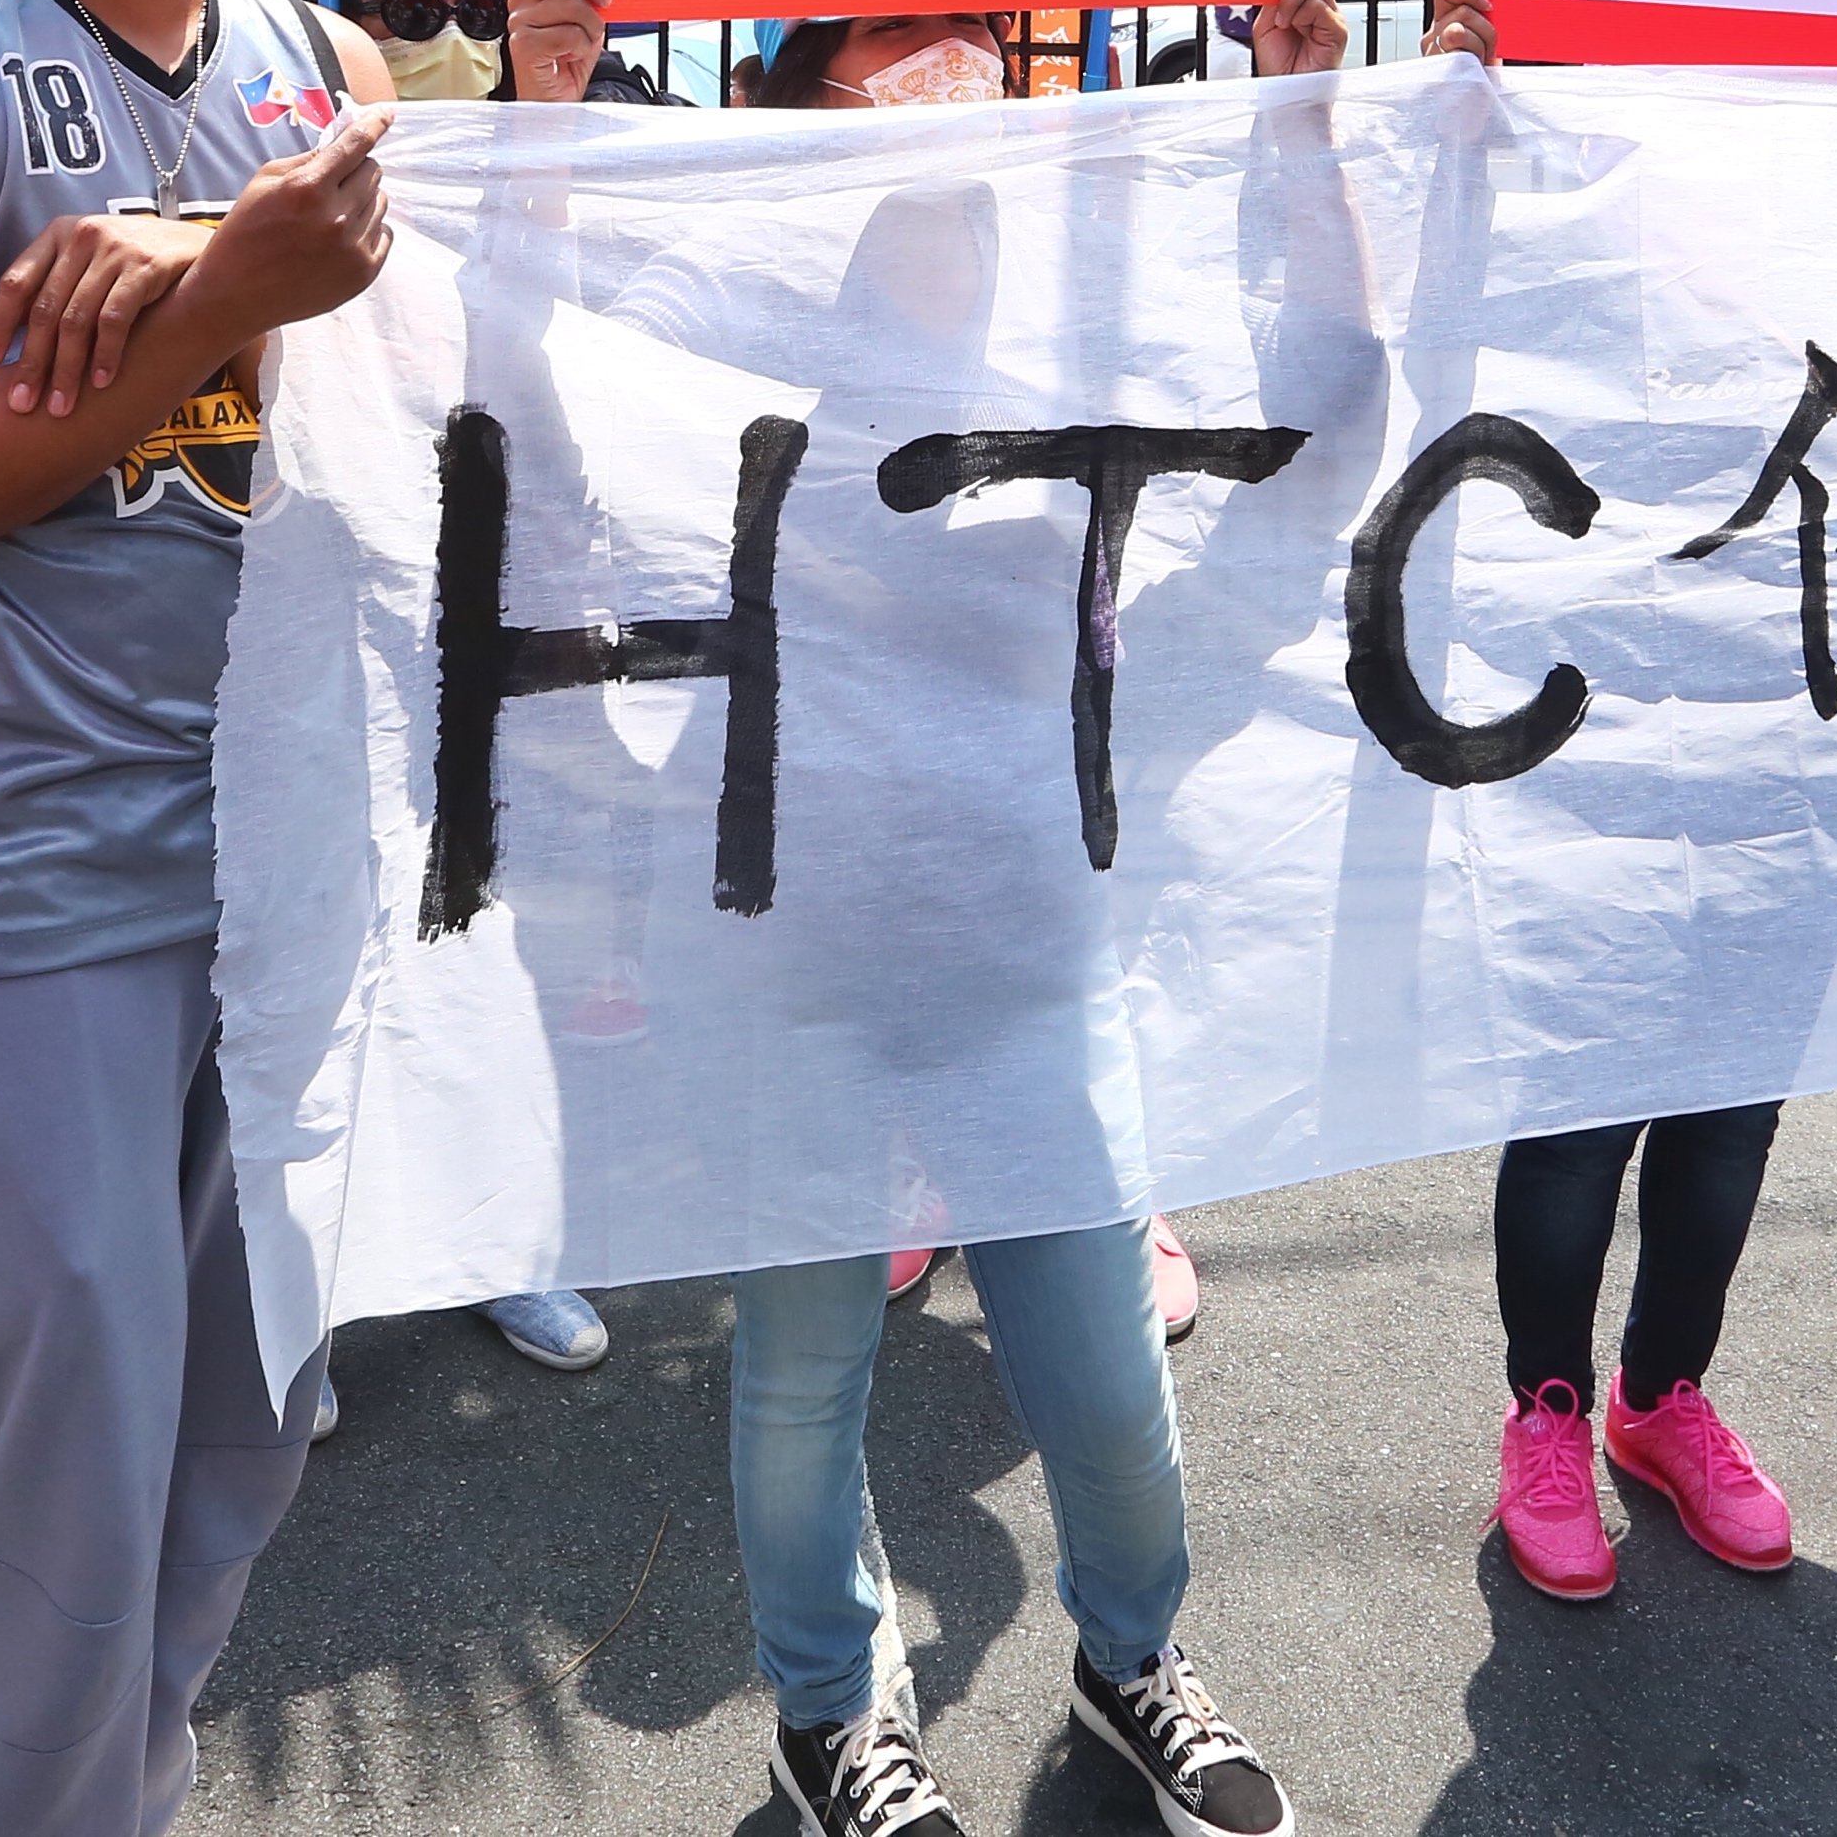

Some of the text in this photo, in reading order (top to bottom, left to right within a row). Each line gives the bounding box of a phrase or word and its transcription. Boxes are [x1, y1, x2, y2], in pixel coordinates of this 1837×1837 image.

[0, 52, 108, 176] 18
[157, 398, 259, 432] ALAX
[415, 399, 1601, 944] HTC
